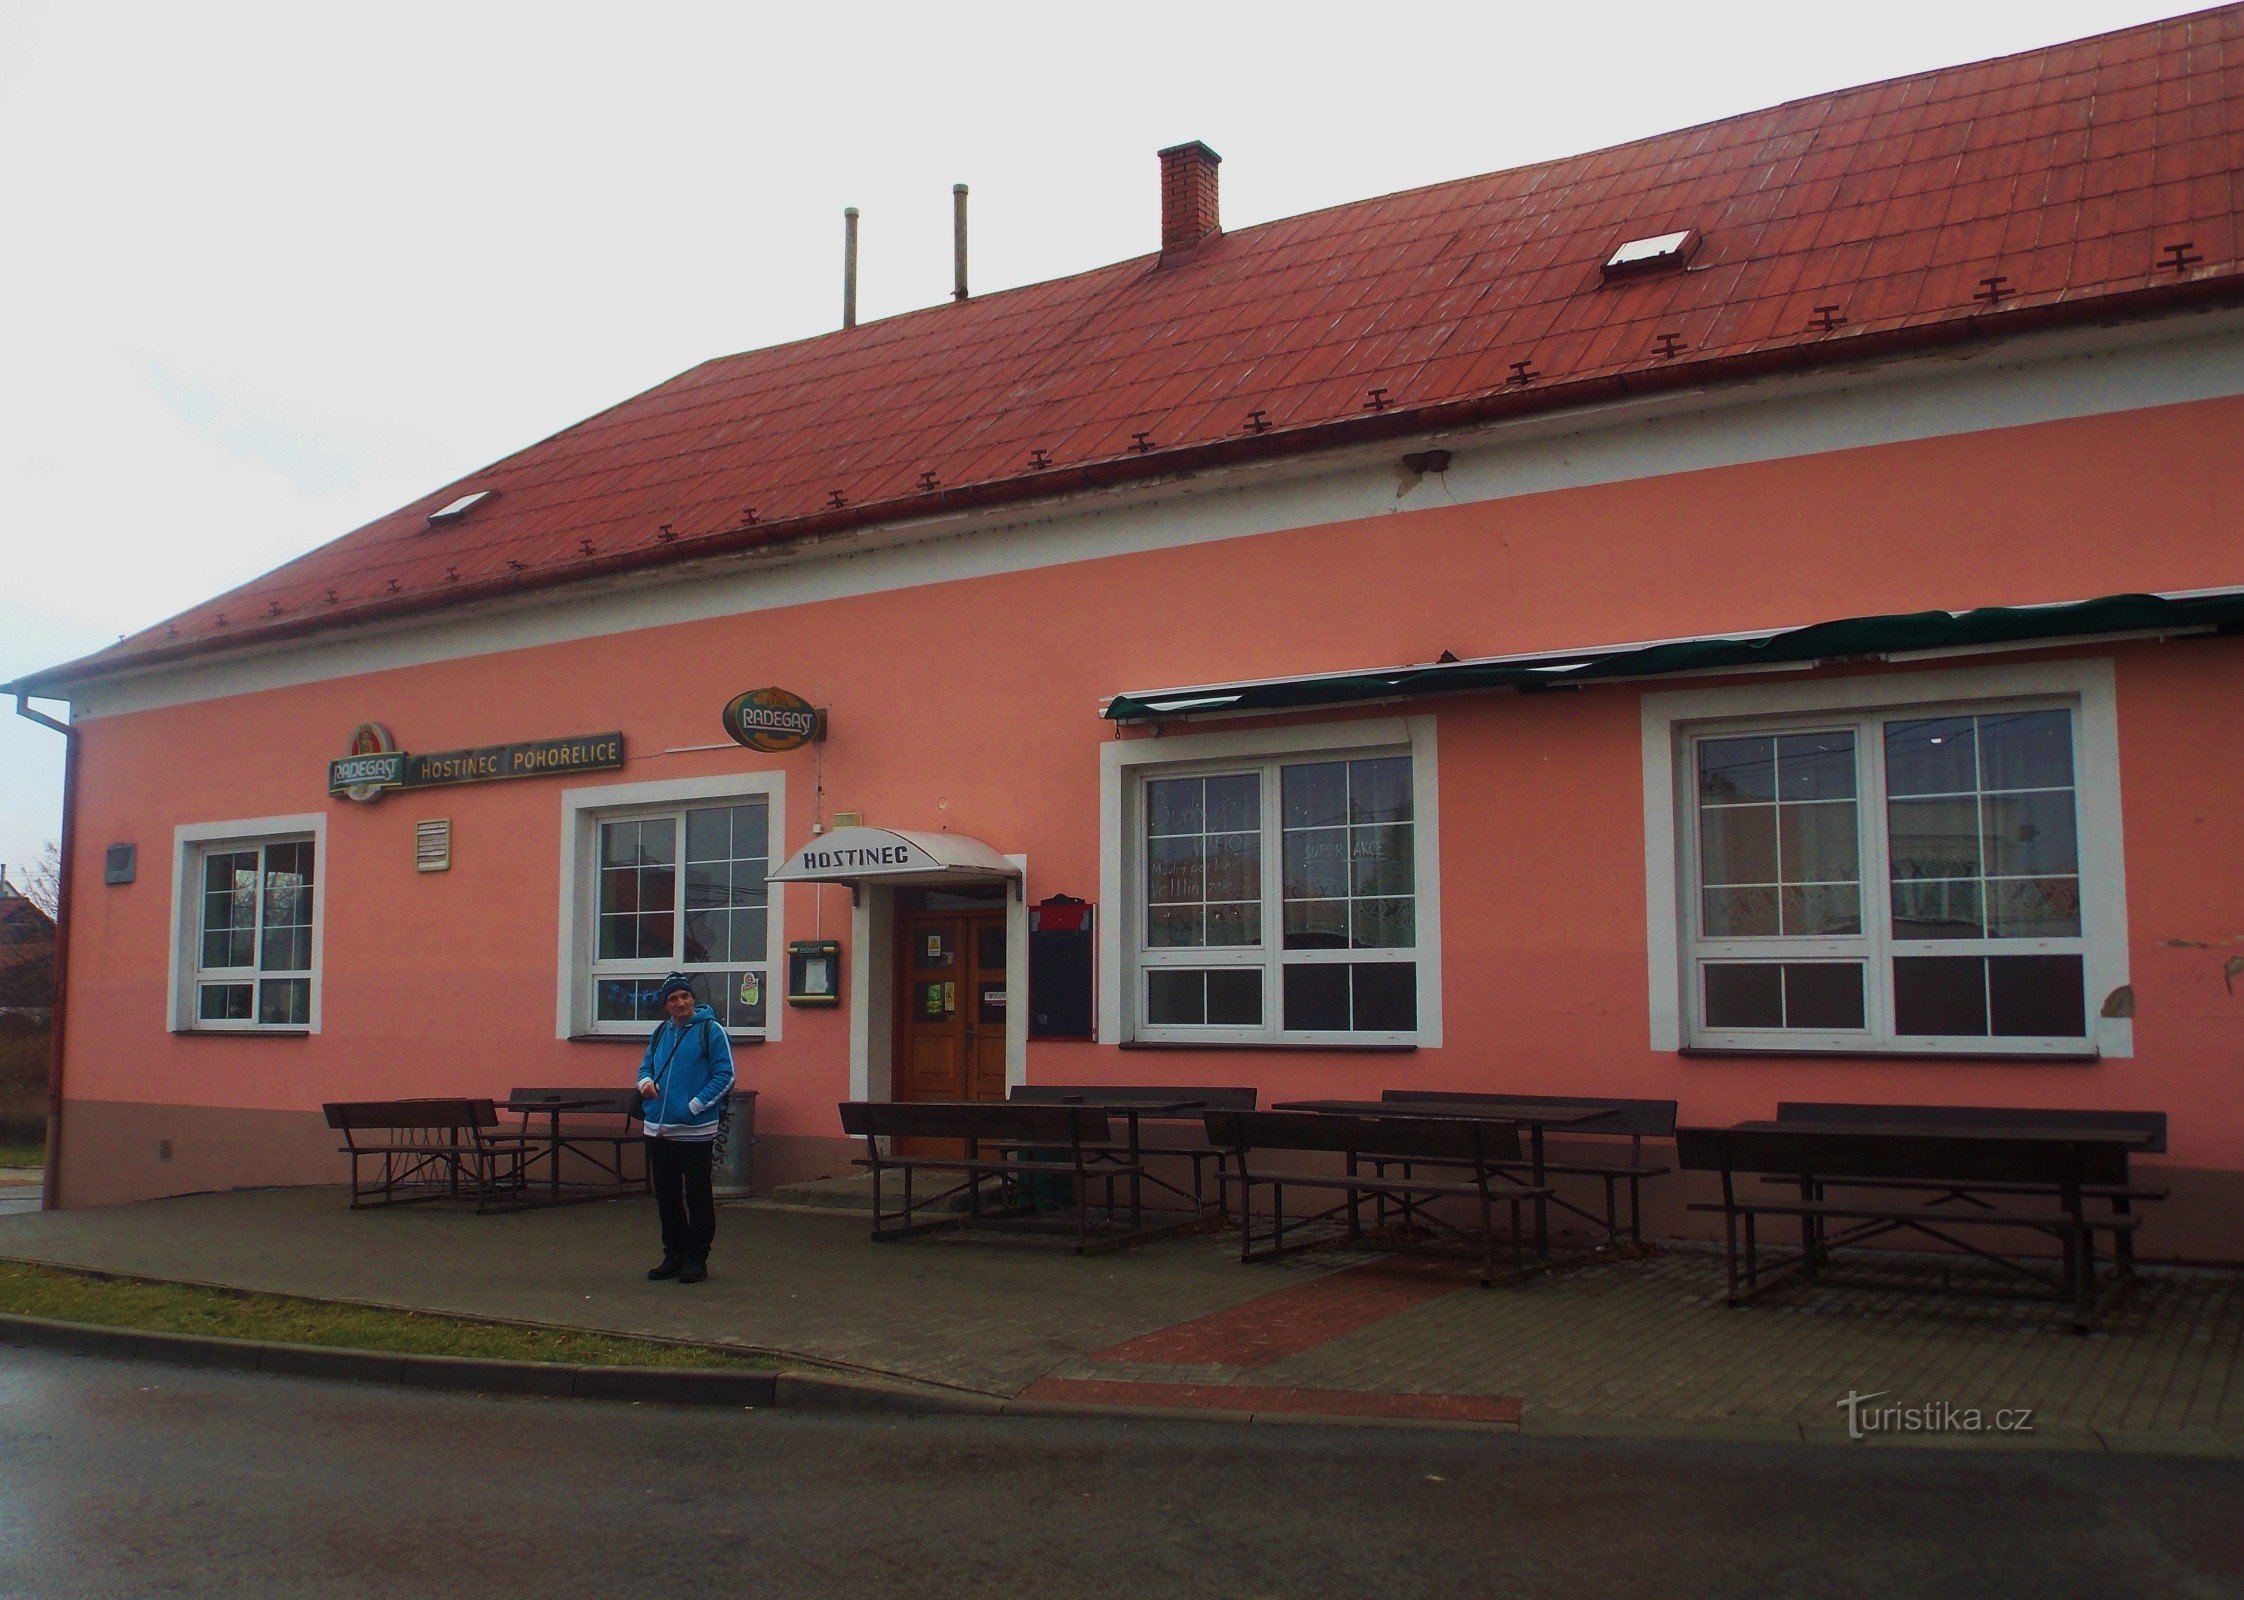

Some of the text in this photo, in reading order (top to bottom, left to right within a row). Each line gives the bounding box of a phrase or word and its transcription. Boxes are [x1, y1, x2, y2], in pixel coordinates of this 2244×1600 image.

[743, 708, 813, 735] RADEGAST
[334, 758, 399, 784] RADEGAST
[421, 742, 617, 779] HOSTINEC POHOŘELICE
[803, 845, 909, 869] HOSTINEC
[1304, 840, 1385, 860] SUPER AKCE
